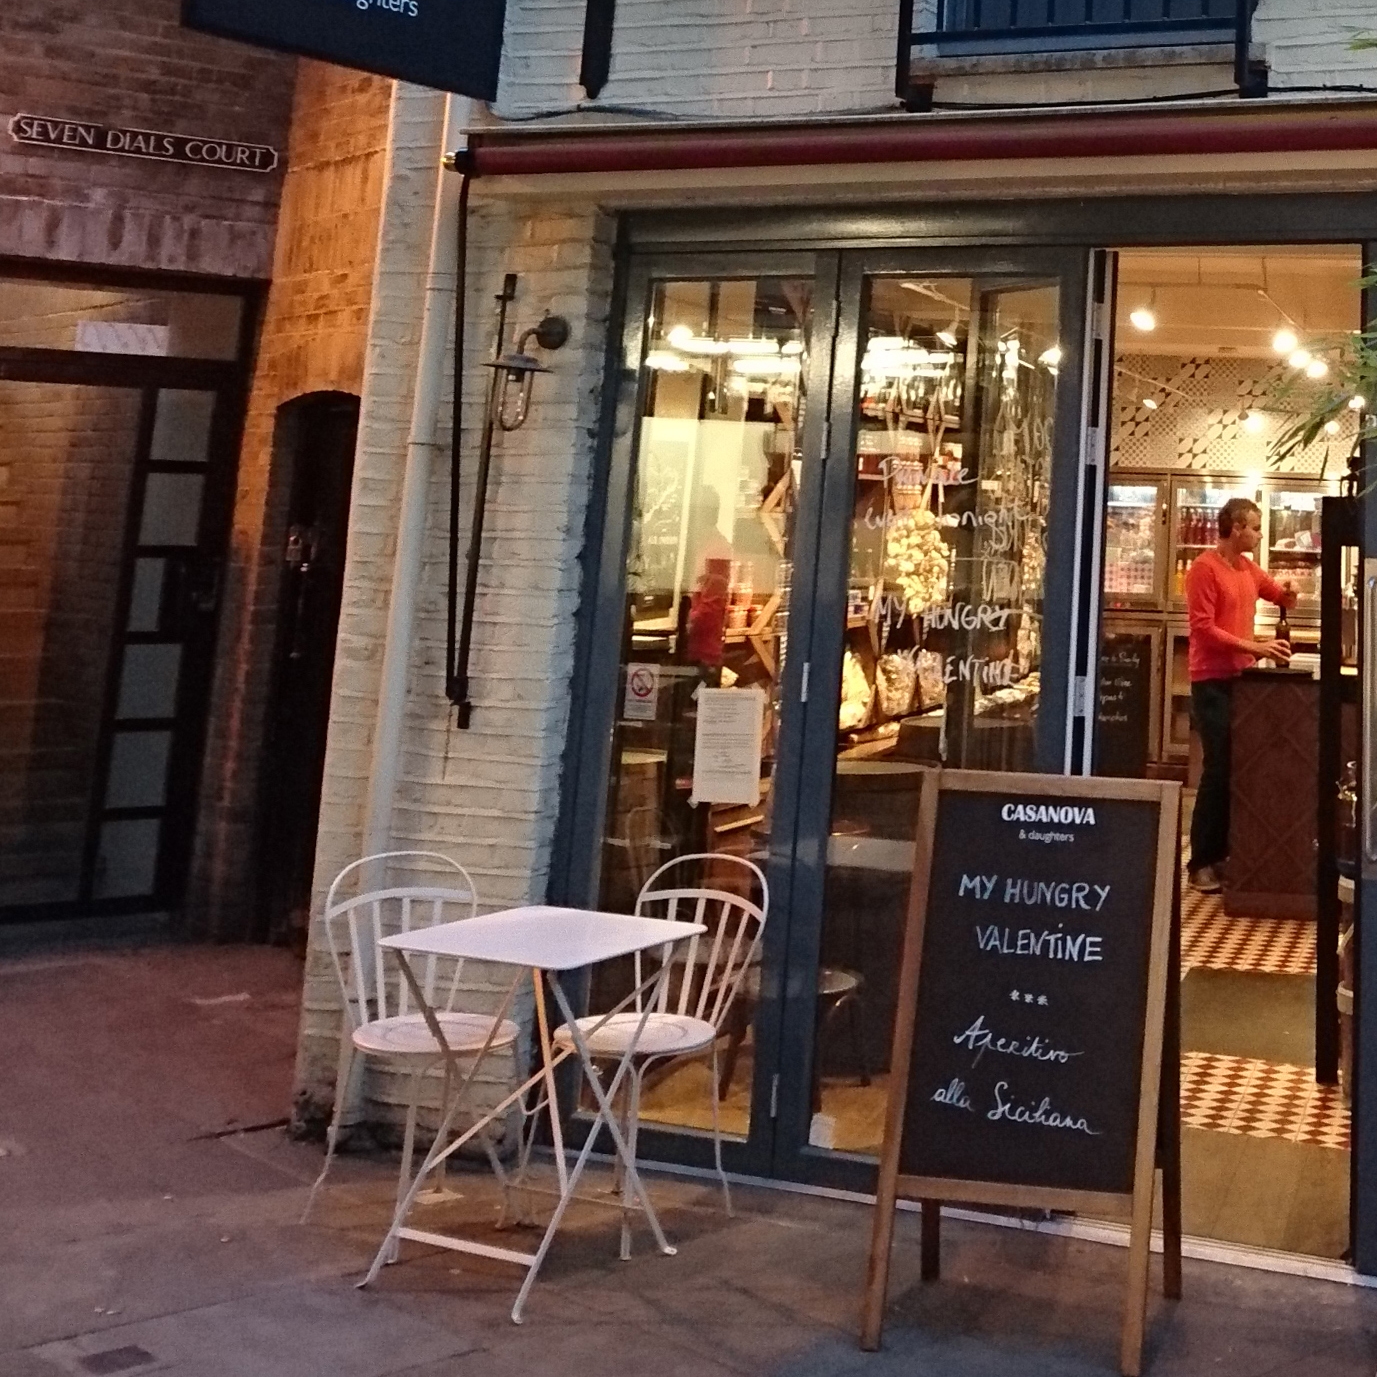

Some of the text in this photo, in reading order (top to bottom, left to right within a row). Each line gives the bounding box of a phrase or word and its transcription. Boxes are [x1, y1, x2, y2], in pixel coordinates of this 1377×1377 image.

[19, 119, 267, 166] SEVEN DIALS COURT
[1001, 803, 1096, 825] CASANOVA
[1018, 829, 1075, 844] & daughters
[958, 874, 1111, 912] MY HUNGRY
[953, 1015, 1085, 1069] Aperitivo
[931, 1077, 1102, 1135] alla Siciliana
